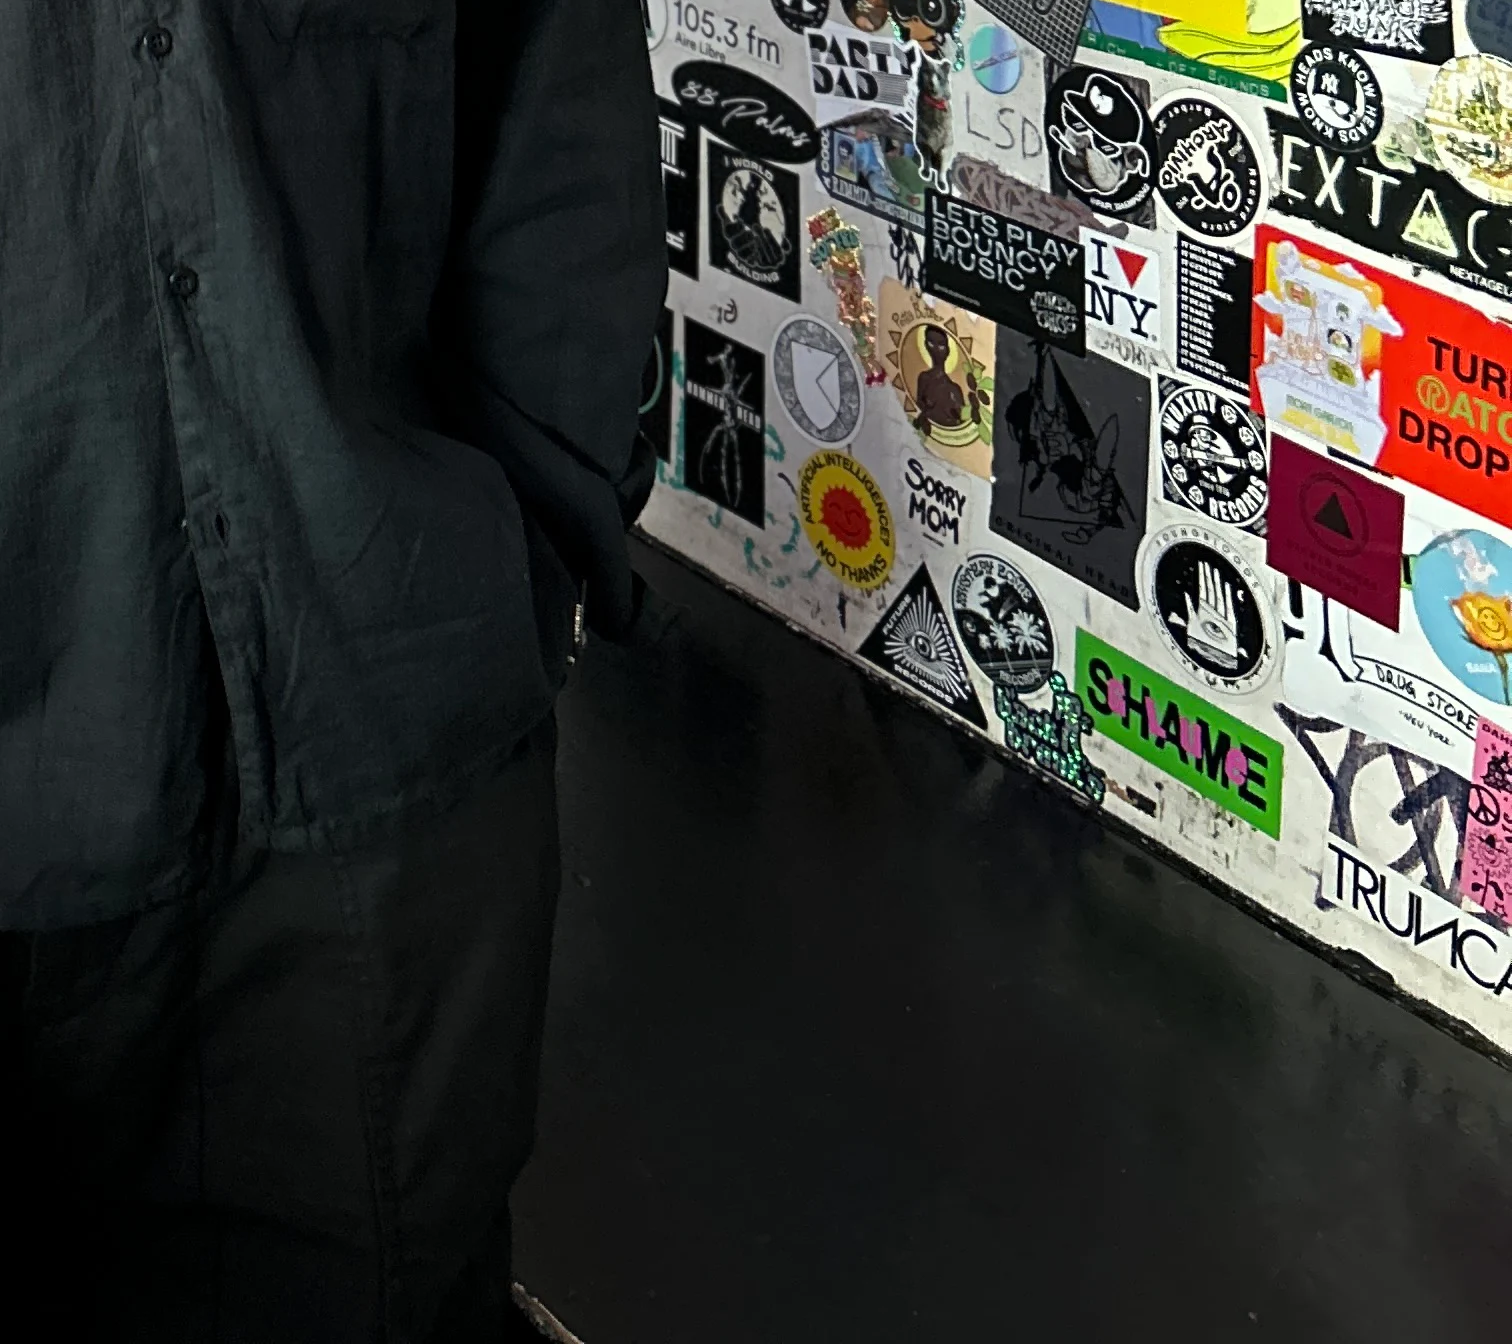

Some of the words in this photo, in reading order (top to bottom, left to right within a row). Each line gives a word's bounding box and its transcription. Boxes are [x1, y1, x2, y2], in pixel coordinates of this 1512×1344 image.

[672, 0, 740, 49] 105.3
[746, 29, 781, 66] fm
[675, 32, 699, 52] Aire
[699, 39, 727, 61] Libre
[814, 66, 879, 101] DAD
[965, 94, 1043, 160] LSD
[932, 196, 1000, 239] LETS
[1006, 222, 1078, 267] PLAY
[933, 220, 1060, 280] BOUNCY
[933, 241, 1025, 292] MUSIC
[1089, 283, 1156, 338] NY
[1163, 390, 1217, 435] WUXTRY
[907, 457, 966, 511] SORRY
[1209, 478, 1268, 521] RECORDS
[908, 491, 960, 537] MOM
[838, 551, 887, 583] THANKS
[883, 593, 914, 638] FUTURE
[893, 662, 955, 706] RECORDS
[1374, 664, 1420, 699] DRUG
[1427, 688, 1478, 732] STORE
